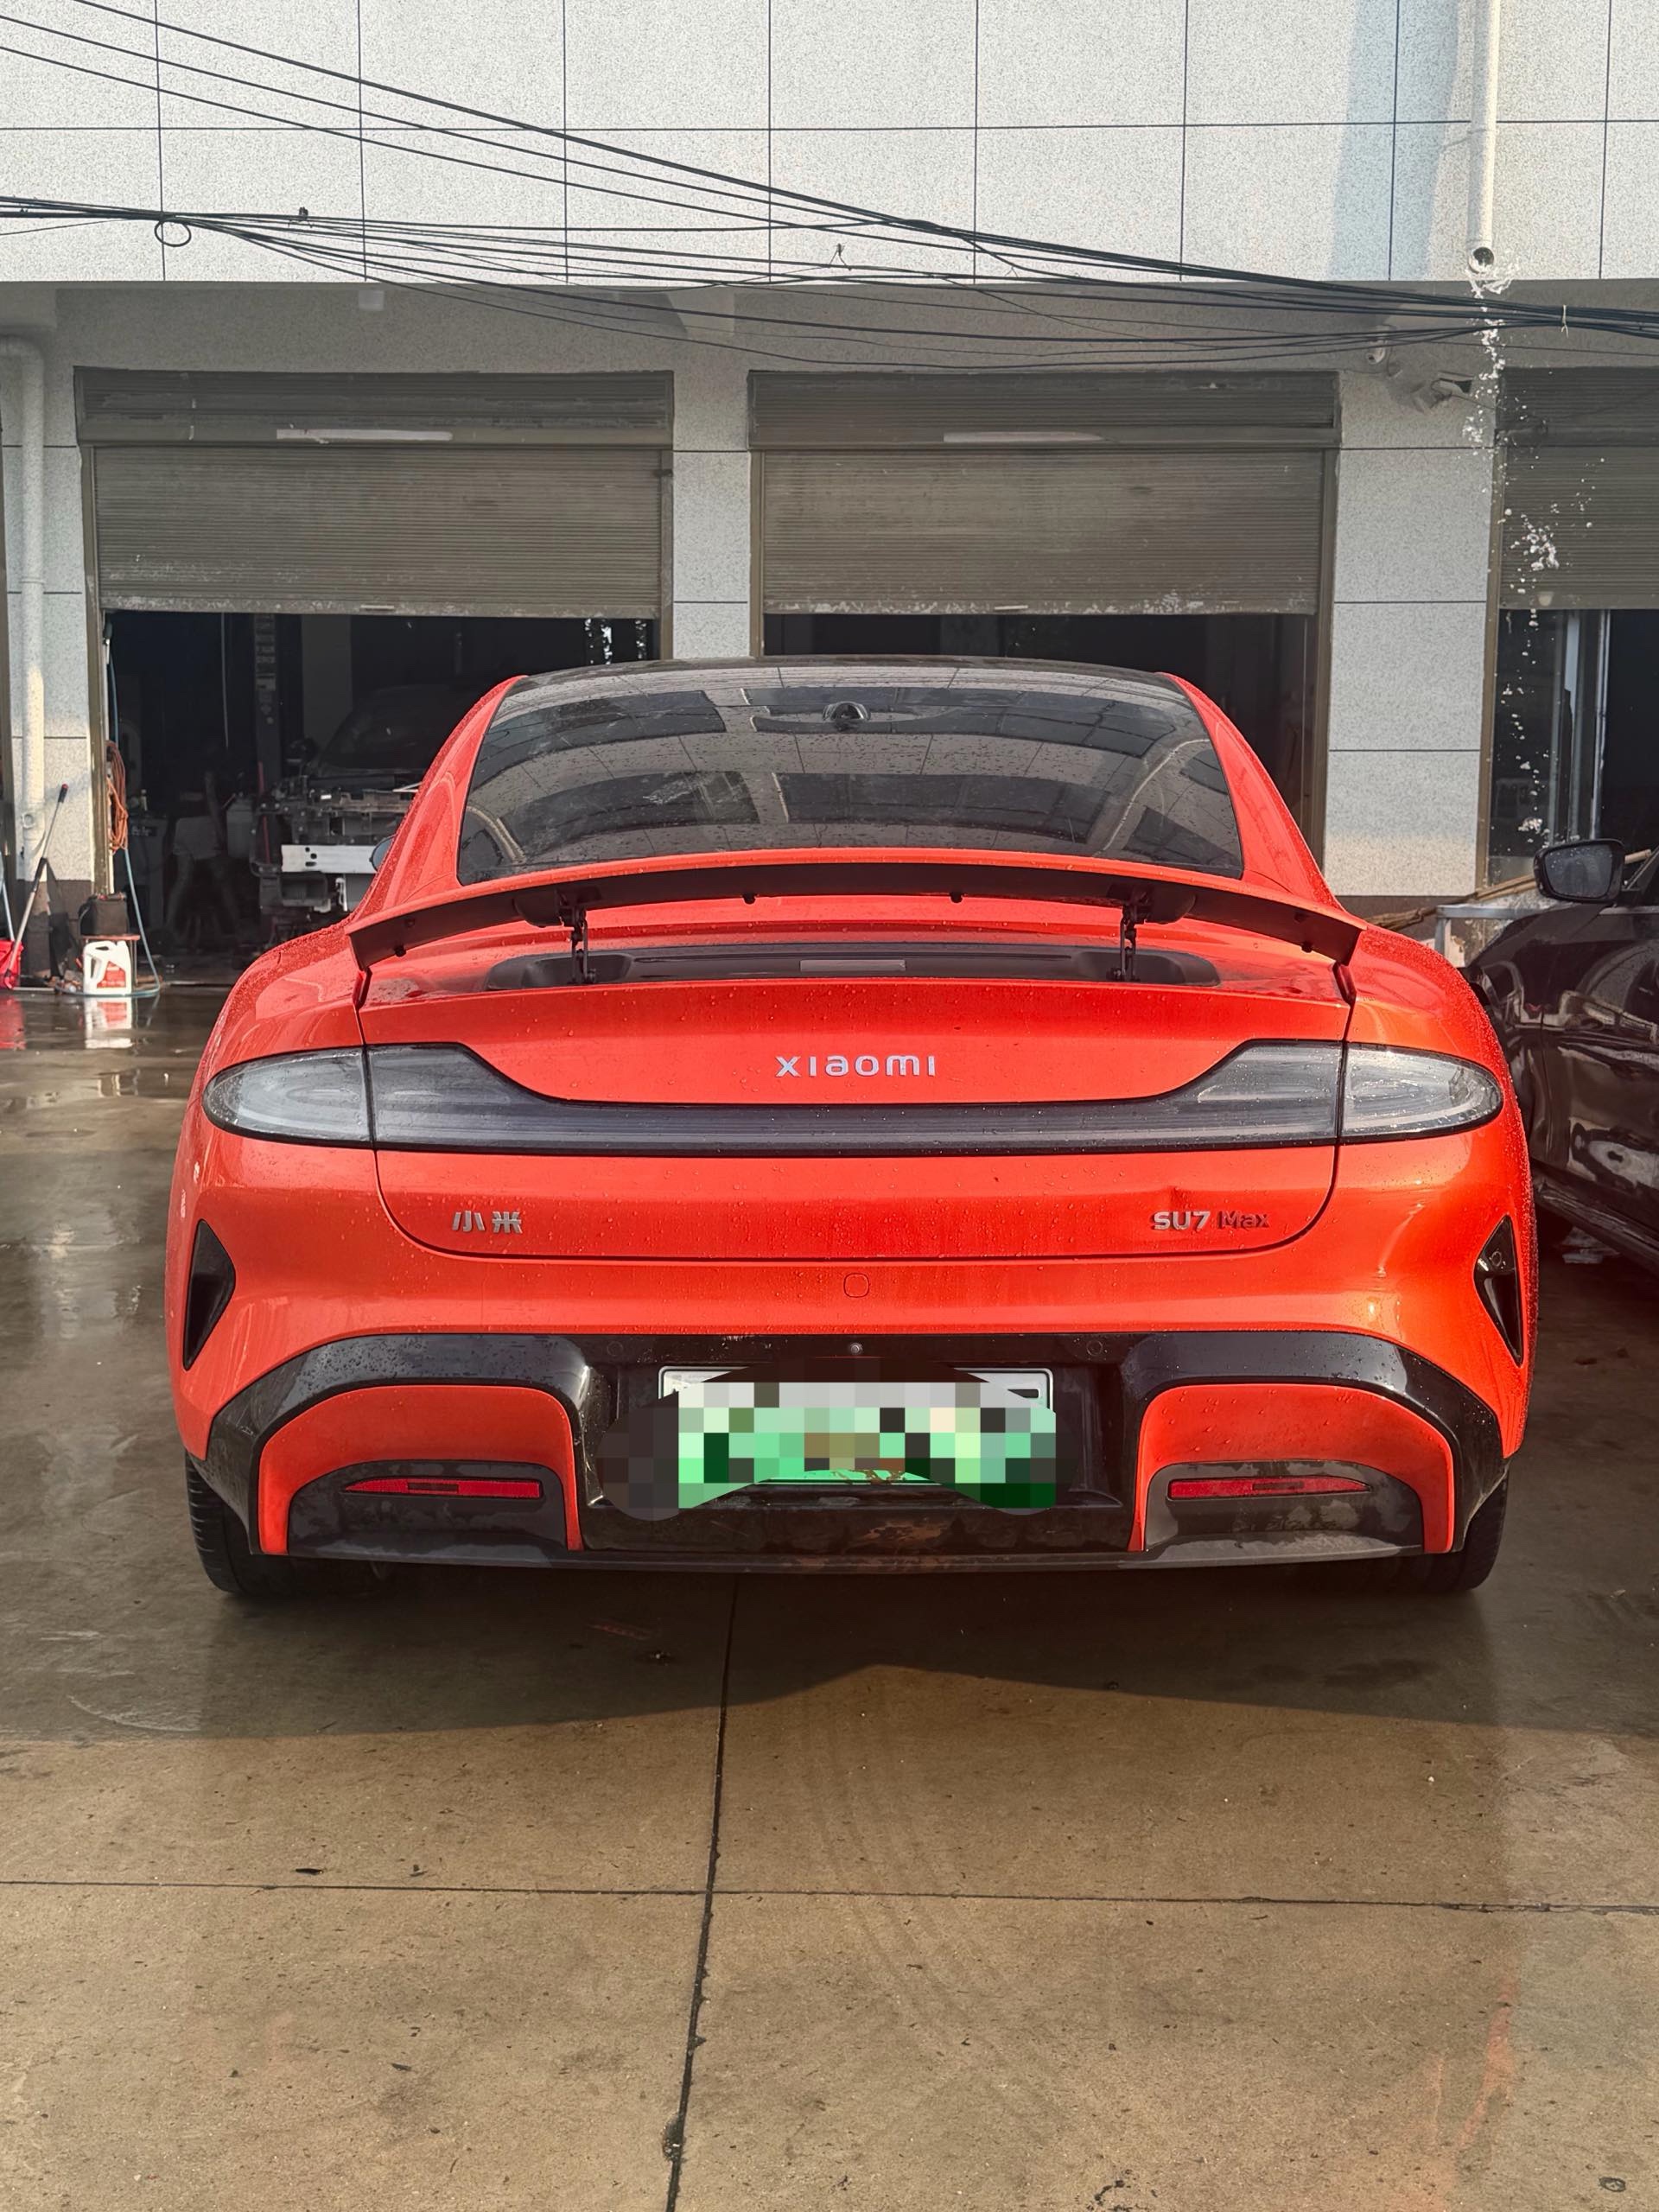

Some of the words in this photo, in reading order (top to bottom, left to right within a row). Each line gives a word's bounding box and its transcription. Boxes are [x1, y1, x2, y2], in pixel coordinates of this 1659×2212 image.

[775, 1055, 936, 1077] xiaomi
[452, 1211, 523, 1234] 小米
[1153, 1211, 1210, 1230] SU7
[1218, 1211, 1270, 1230] Max
